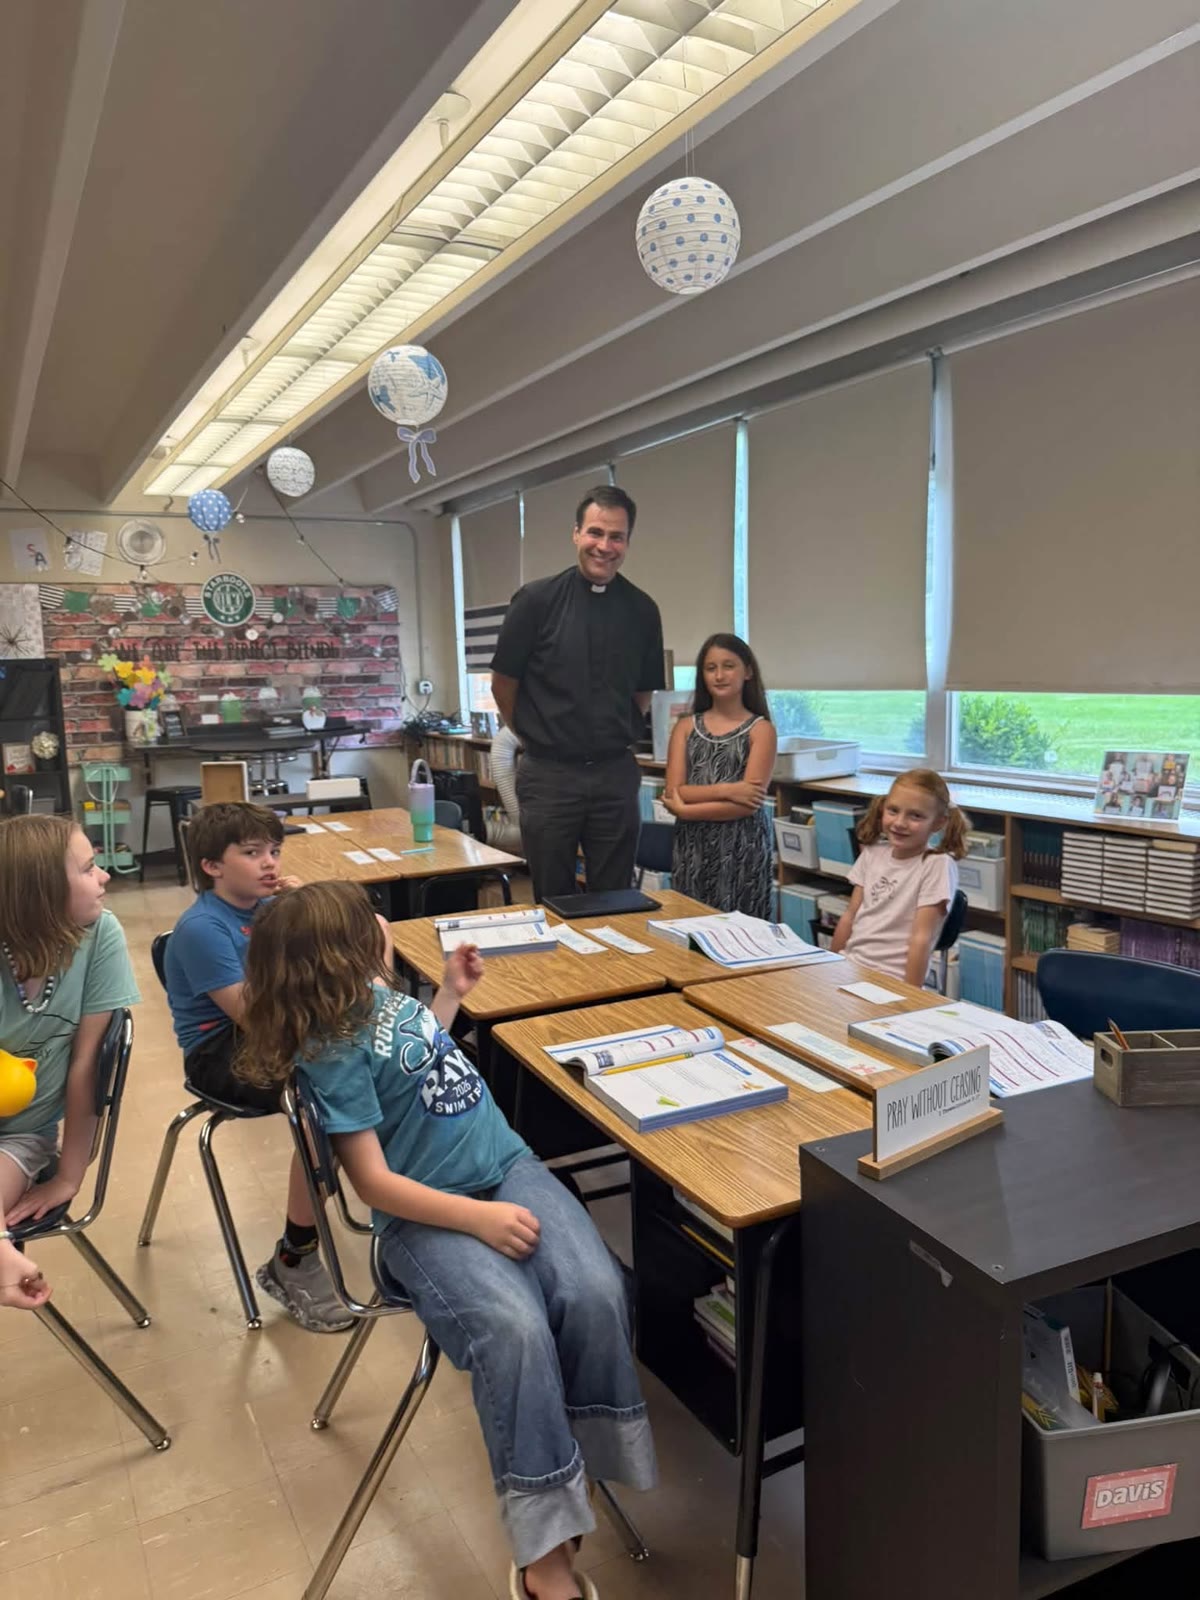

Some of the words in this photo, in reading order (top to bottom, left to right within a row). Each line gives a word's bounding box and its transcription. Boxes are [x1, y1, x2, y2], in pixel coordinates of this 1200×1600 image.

[204, 575, 251, 598] STARBOOKS
[452, 1080, 472, 1097] 2026
[887, 1096, 909, 1132] PRAY
[911, 1080, 947, 1120] WITHOUT
[950, 1065, 981, 1103] CEASING
[435, 1101, 467, 1114] SWIM
[1096, 1480, 1164, 1508] Davis
